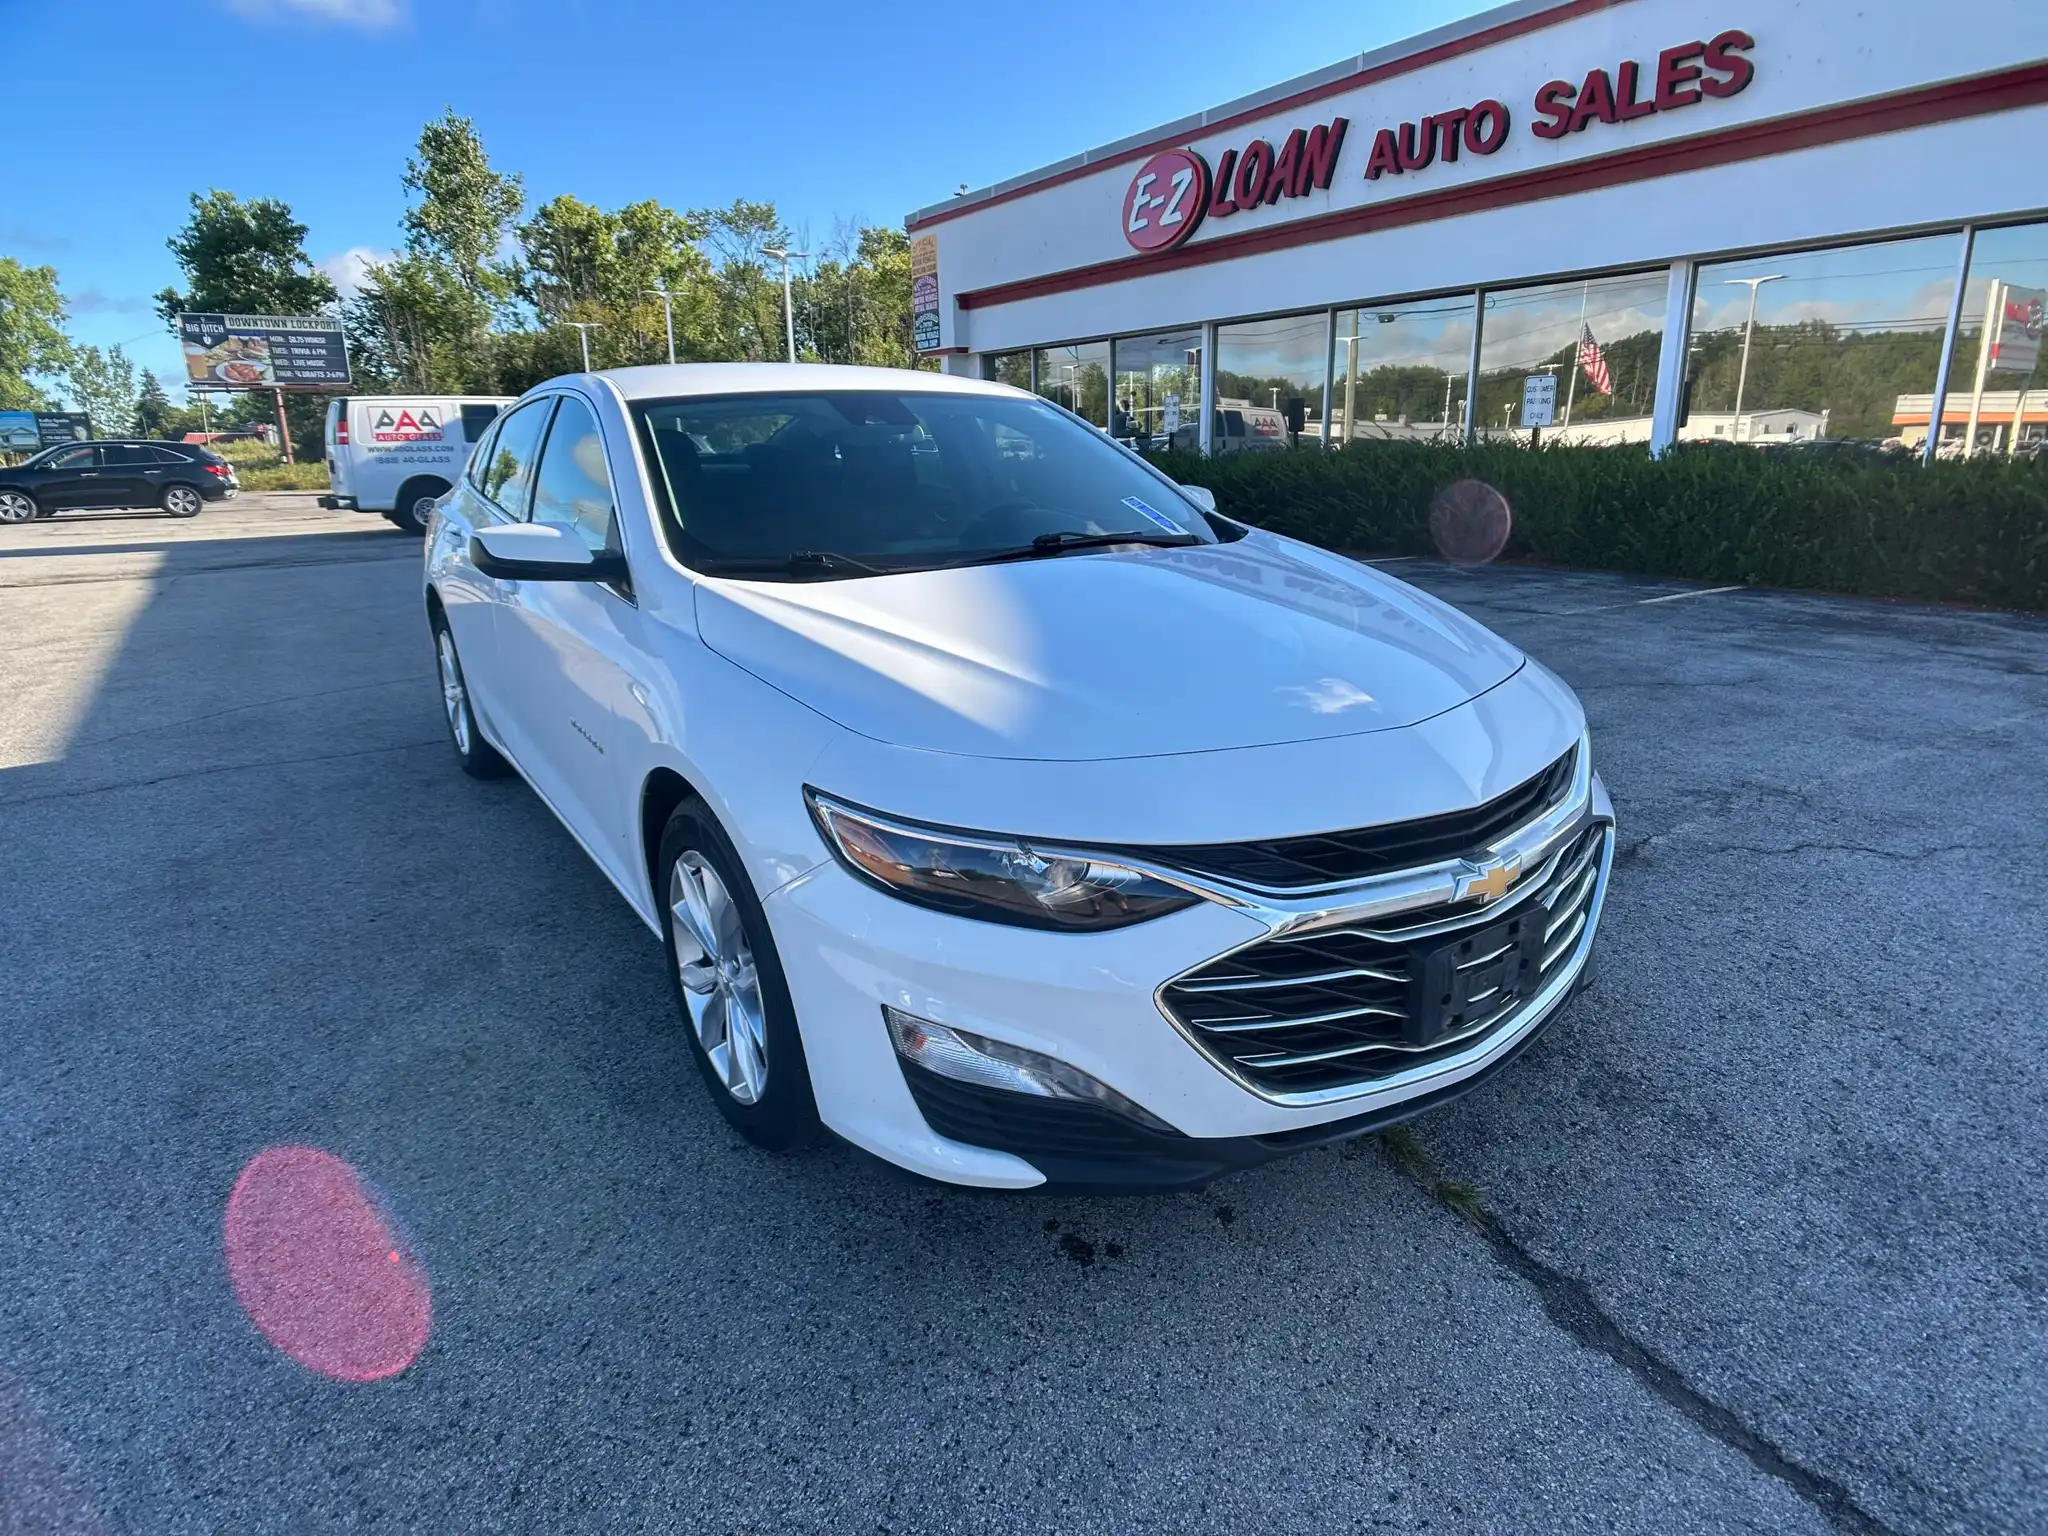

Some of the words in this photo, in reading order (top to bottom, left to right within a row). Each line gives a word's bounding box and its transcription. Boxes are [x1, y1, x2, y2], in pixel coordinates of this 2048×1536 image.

[1130, 167, 1196, 233] E-Z
[1209, 117, 1348, 217] LOAN
[1364, 99, 1510, 181] AUTO
[1531, 28, 1755, 139] SALES
[185, 323, 199, 333] BIG
[201, 323, 225, 333] DITCH
[228, 317, 287, 329] DOWNTOWN
[291, 319, 337, 331] LOCKPORT
[291, 347, 311, 355] TRIVIA
[292, 359, 306, 367] LIVE
[374, 409, 442, 432] AAA
